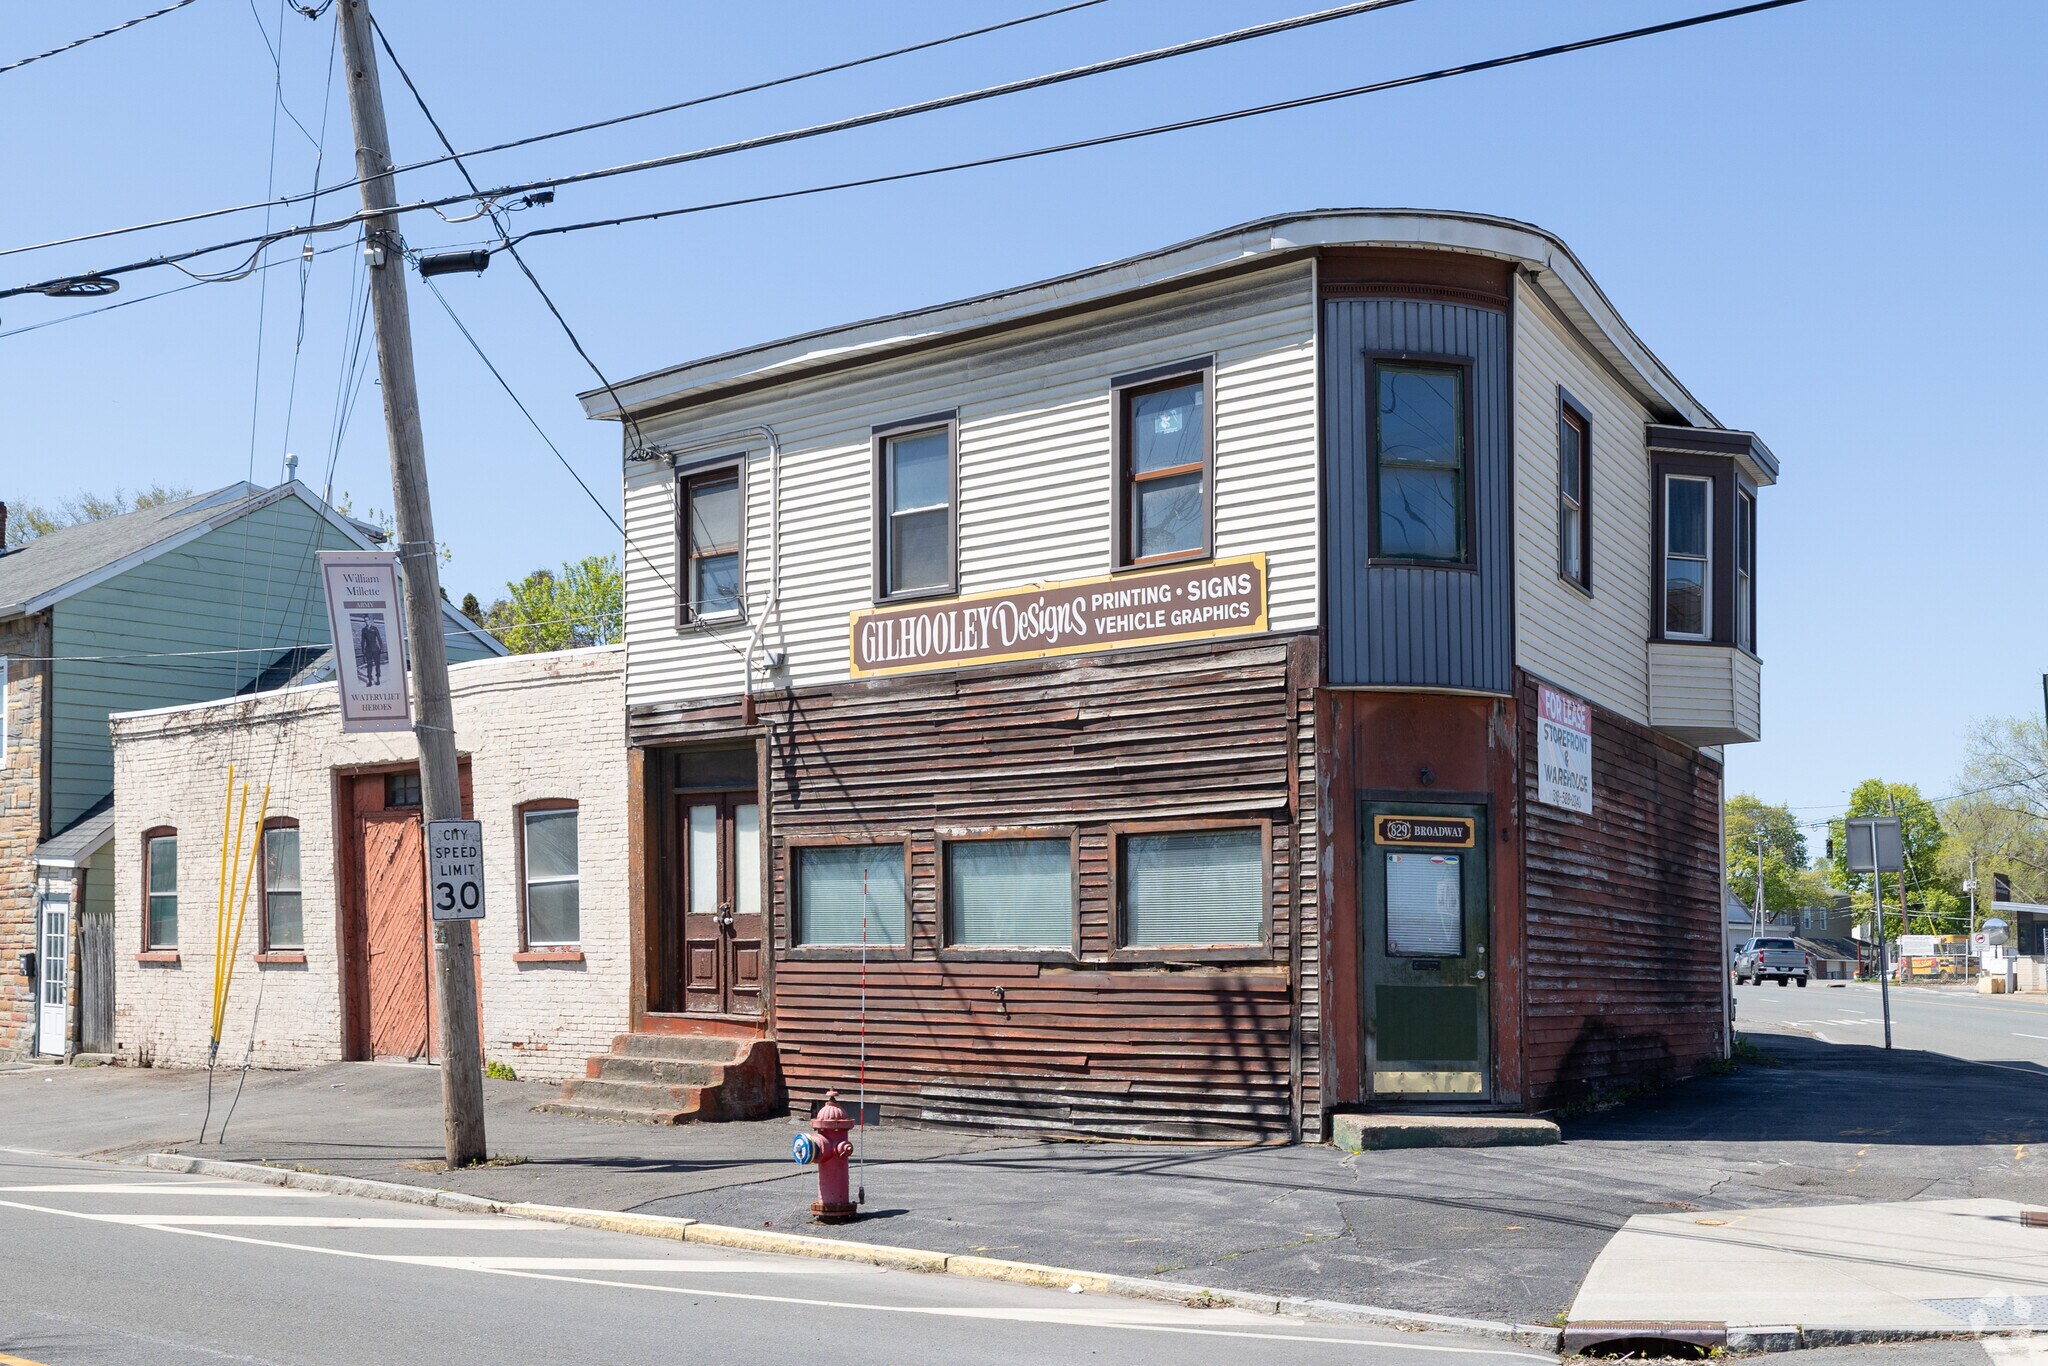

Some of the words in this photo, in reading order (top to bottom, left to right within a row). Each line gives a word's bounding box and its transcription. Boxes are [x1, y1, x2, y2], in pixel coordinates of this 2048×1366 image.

[343, 573, 380, 584] William
[346, 586, 380, 597] Millette
[1091, 584, 1172, 612] PRINTING
[1187, 573, 1252, 601] SIGNS
[1094, 610, 1166, 635] VEHICLE
[1170, 601, 1250, 626] GRAPHICS
[861, 606, 993, 664] GILHOOLEY
[351, 692, 401, 701] WATERVLIET
[361, 703, 393, 712] HEROES
[1544, 689, 1562, 722] FOR
[1563, 698, 1586, 731] LEASE
[1543, 722, 1588, 755] STOREFRONT
[1564, 750, 1569, 767] &
[1543, 763, 1588, 793] WAREHOUSE
[443, 828, 468, 841] CITY
[1390, 824, 1408, 837] 829
[1414, 826, 1464, 838] BROADWAY
[435, 846, 477, 859] SPEED
[440, 864, 475, 877] LIMIT
[436, 881, 480, 911] 30
